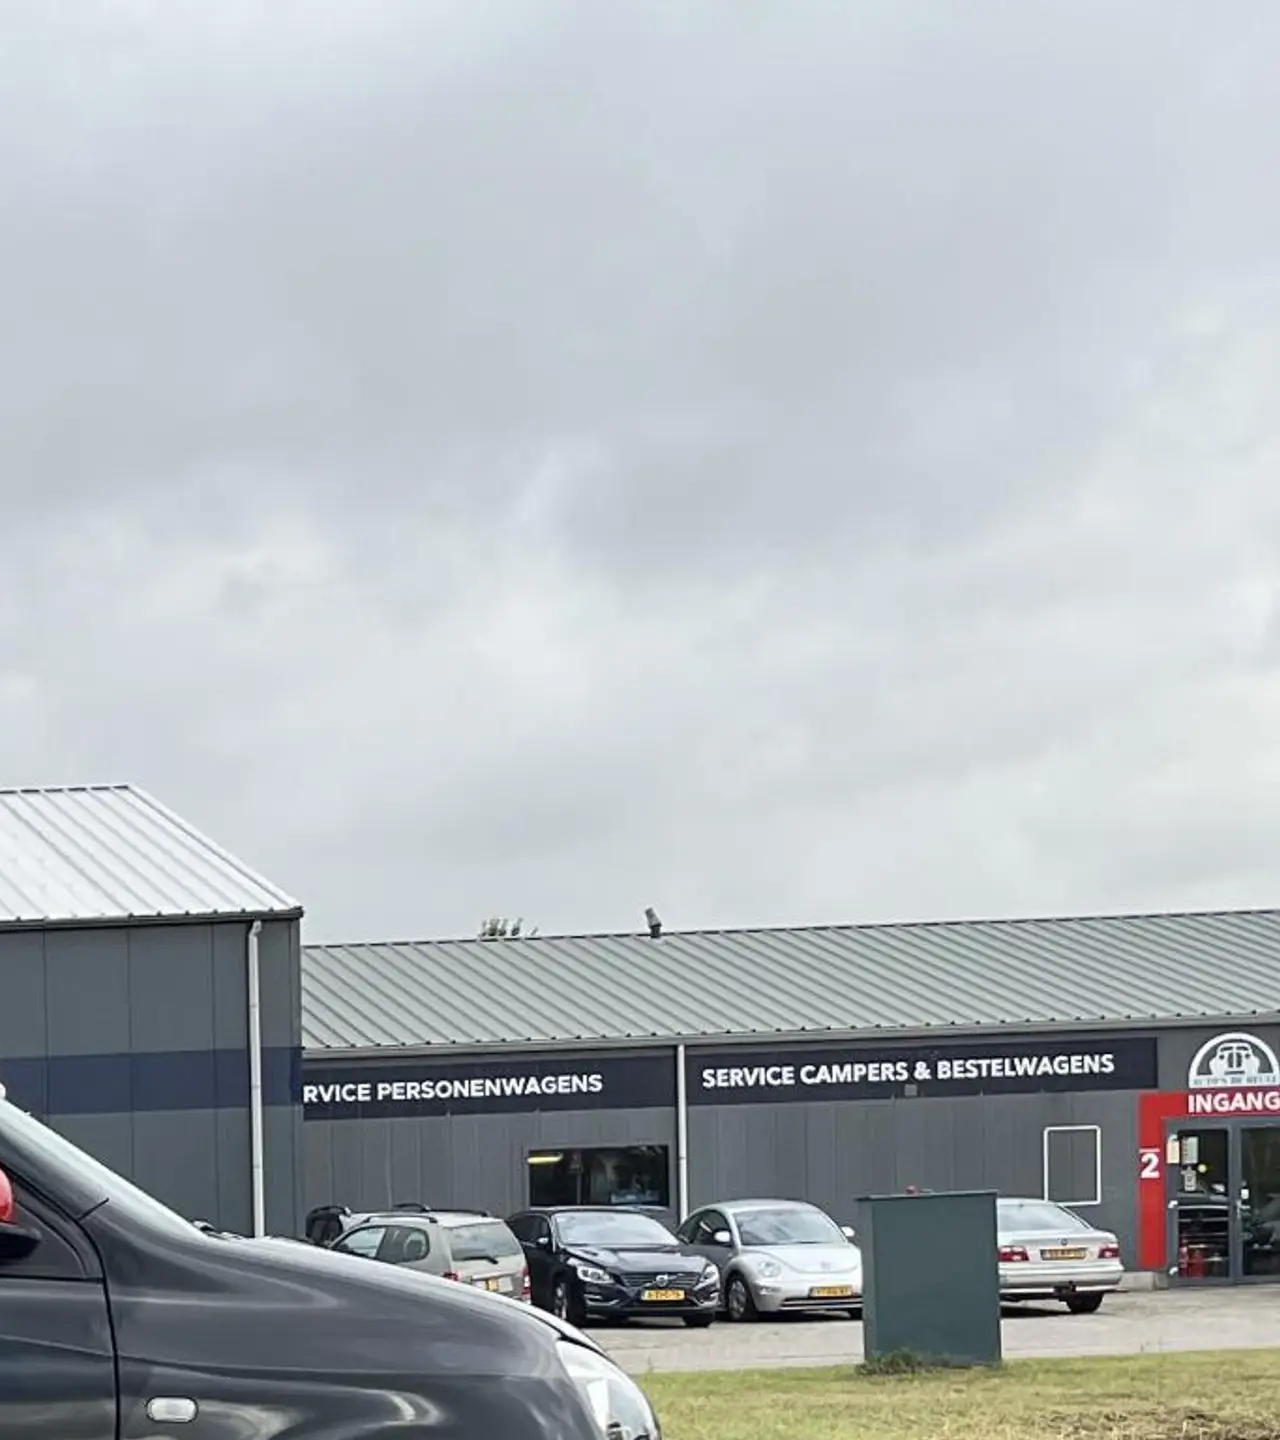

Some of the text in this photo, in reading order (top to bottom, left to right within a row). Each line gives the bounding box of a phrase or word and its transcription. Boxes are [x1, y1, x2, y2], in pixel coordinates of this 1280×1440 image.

[702, 1053, 1115, 1088] SERVICE CAMPERS & BESTELWAGENS
[303, 1074, 603, 1103] RVICE PERSONENWAGENS
[1188, 1091, 1280, 1113] INGANG
[1140, 1152, 1160, 1179] 2
